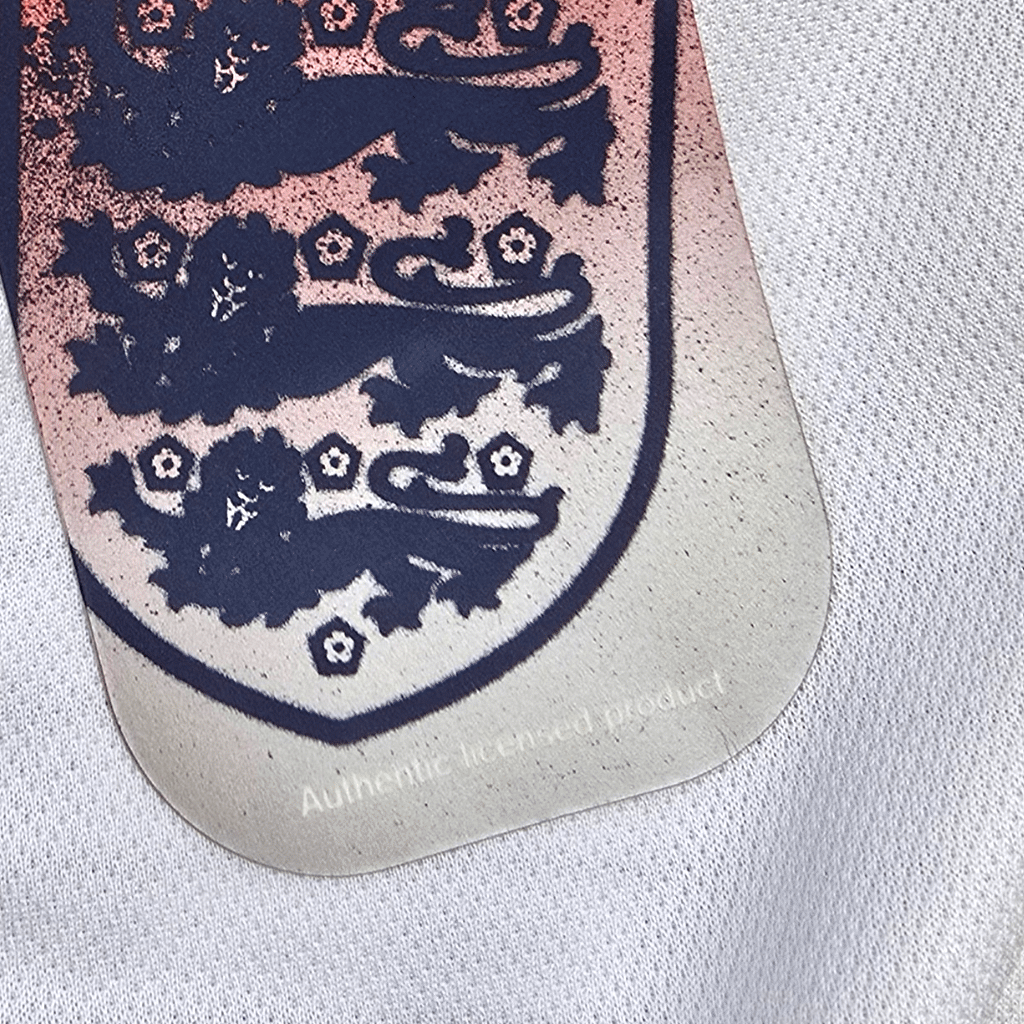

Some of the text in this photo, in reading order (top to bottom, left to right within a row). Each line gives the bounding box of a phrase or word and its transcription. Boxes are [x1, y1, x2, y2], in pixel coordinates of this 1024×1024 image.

[301, 669, 725, 817] Authentic licensed product
